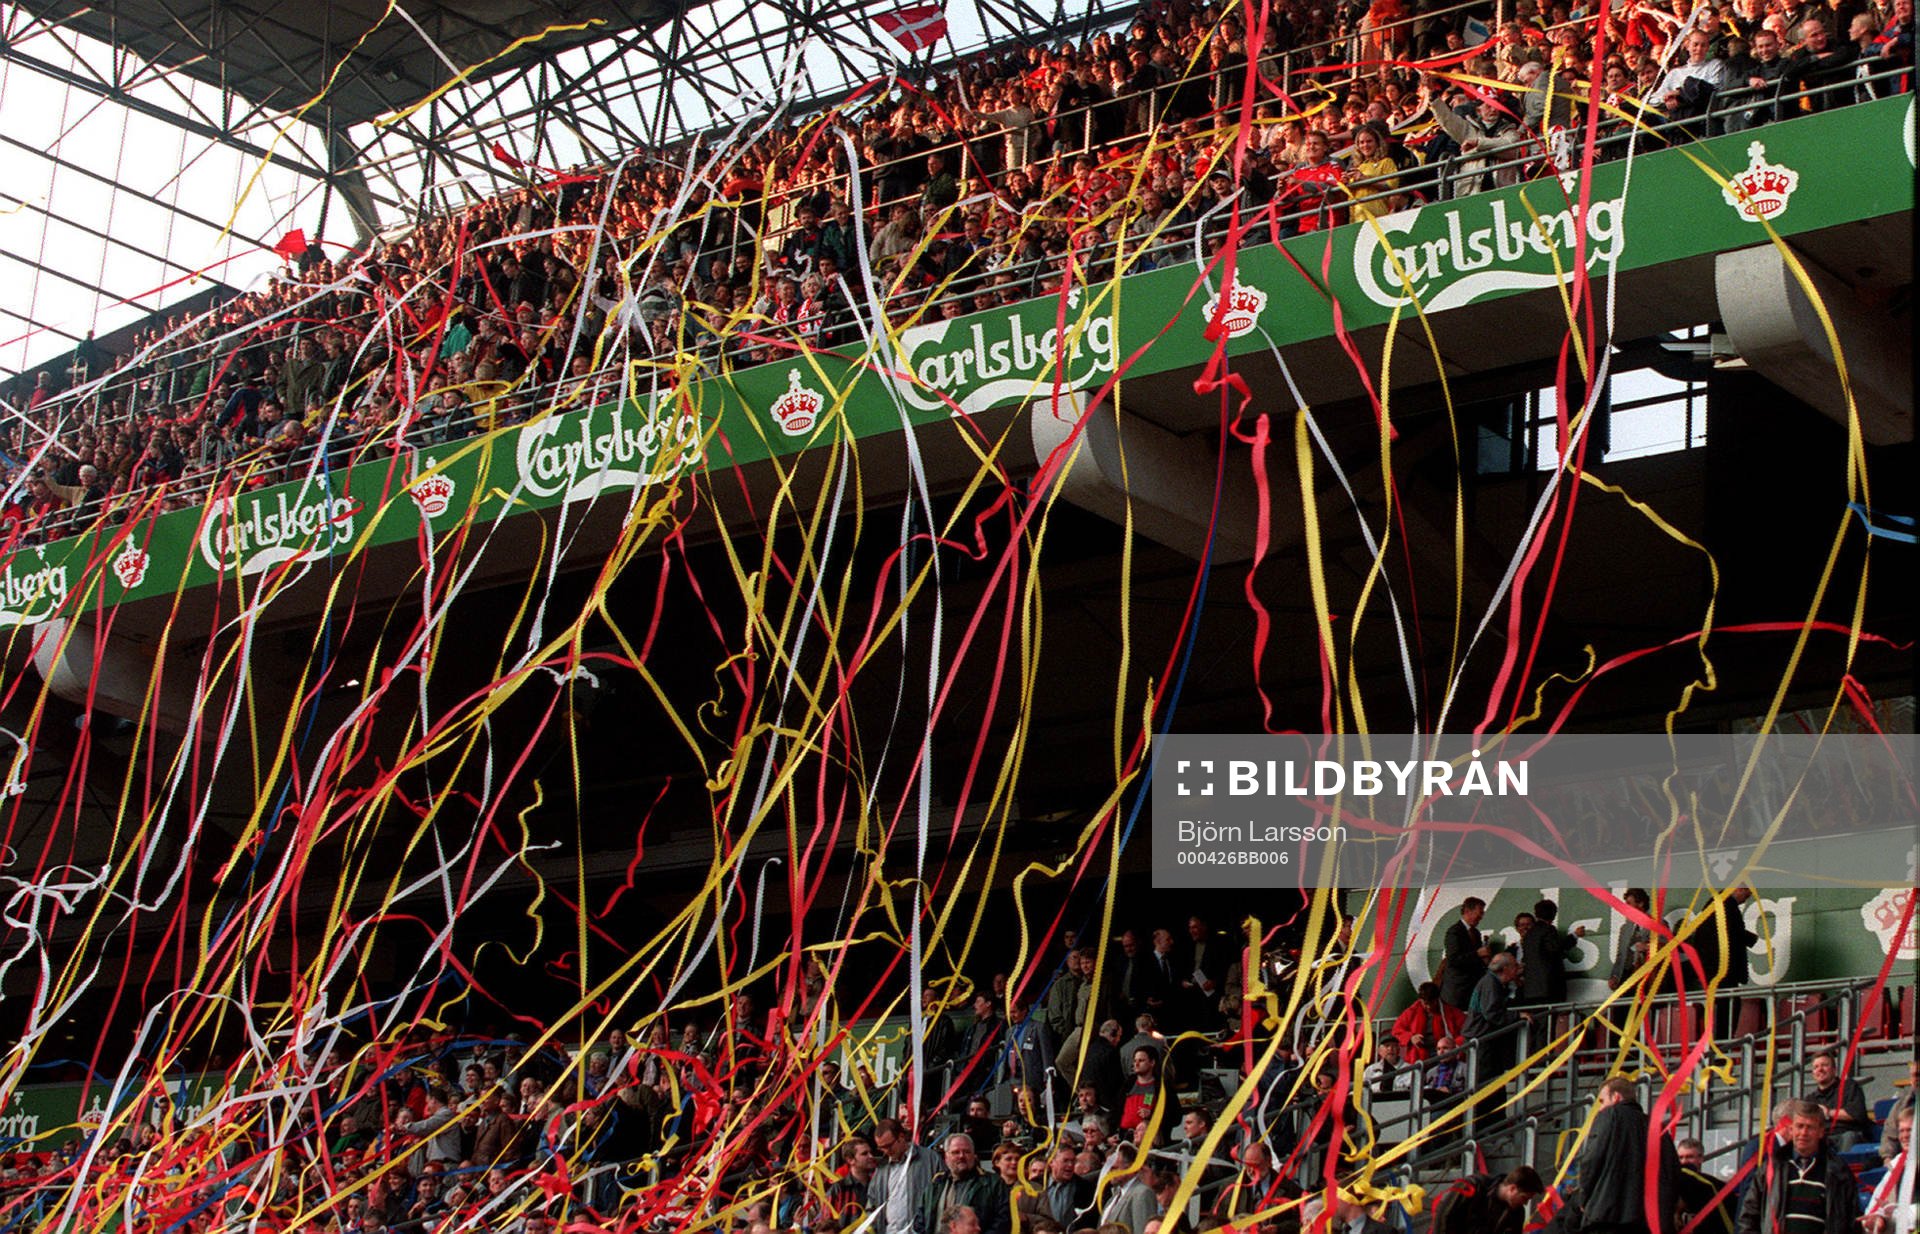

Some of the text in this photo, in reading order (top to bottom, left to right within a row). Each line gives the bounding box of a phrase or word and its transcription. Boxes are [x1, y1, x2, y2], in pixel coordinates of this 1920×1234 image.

[1354, 197, 1624, 313] Carlsberg
[895, 313, 1119, 417] Carlsberg
[516, 410, 703, 501] Carlsberg
[200, 492, 354, 576] Carlsberg
